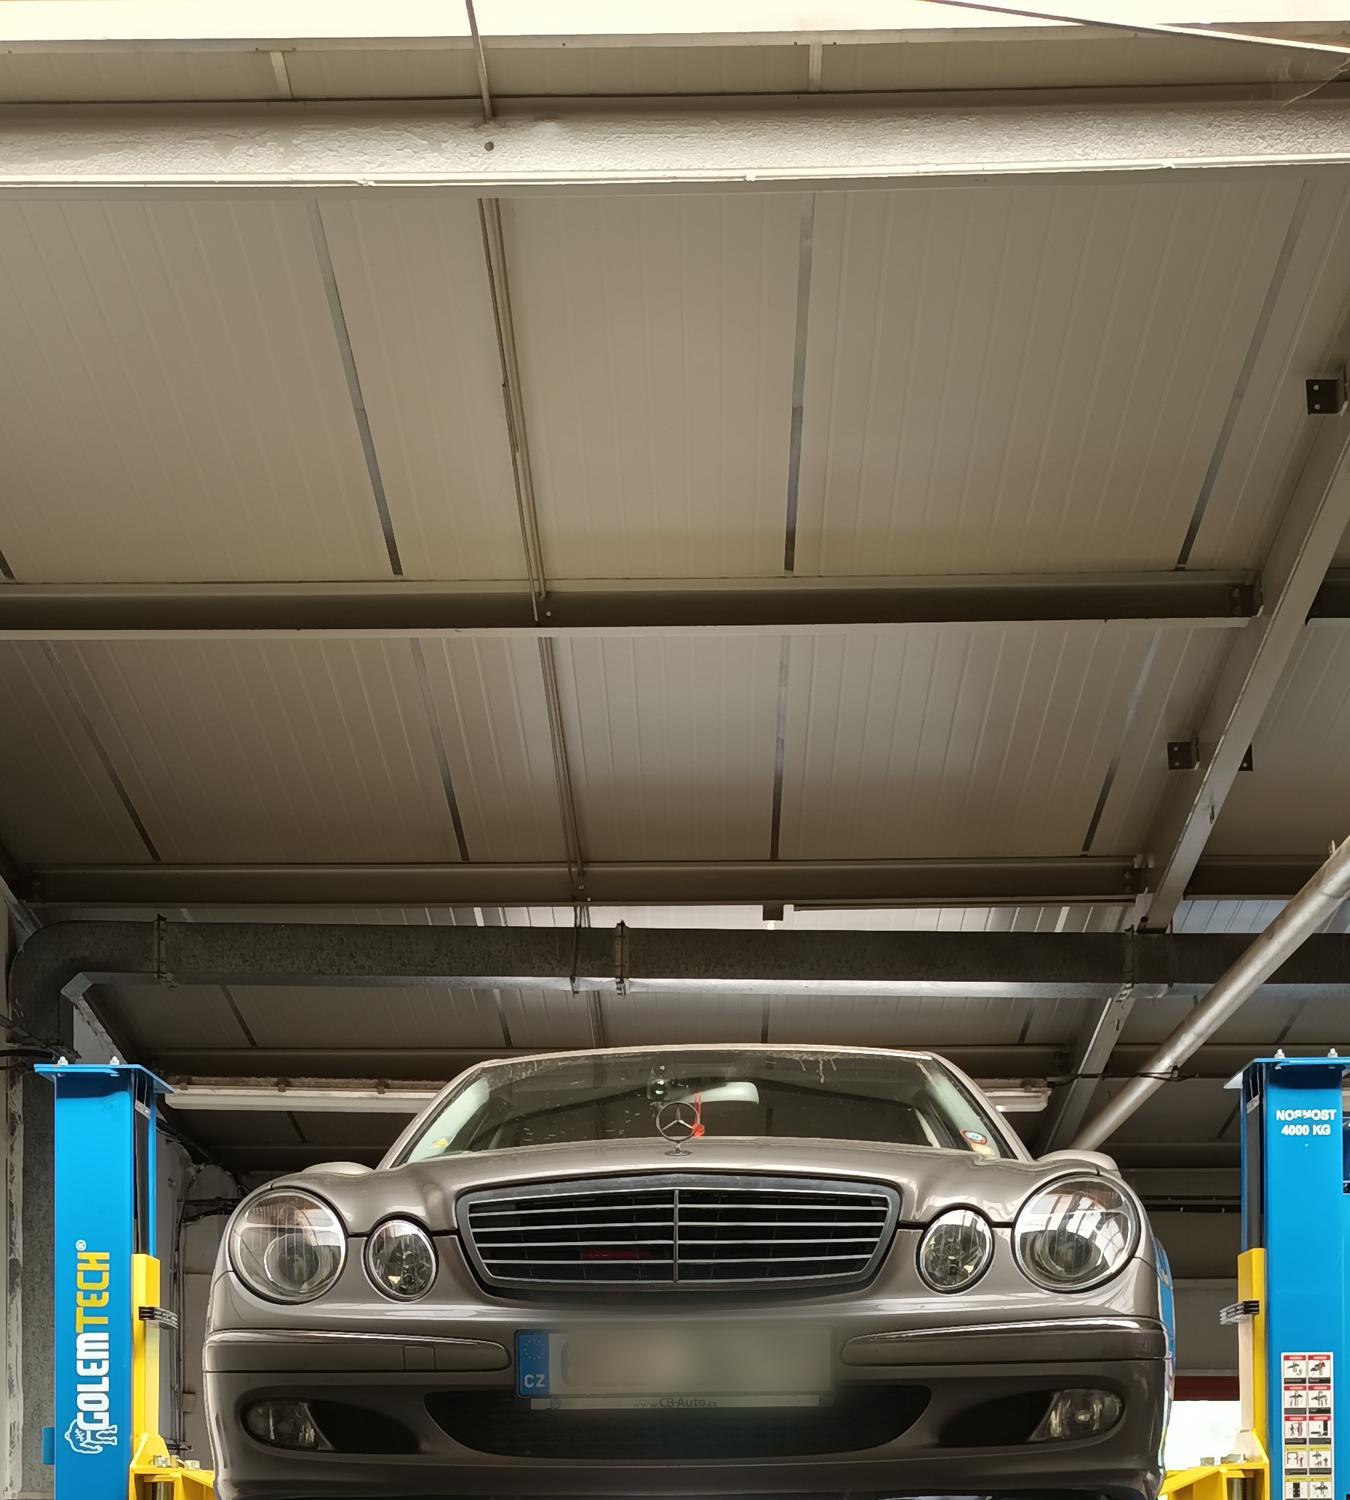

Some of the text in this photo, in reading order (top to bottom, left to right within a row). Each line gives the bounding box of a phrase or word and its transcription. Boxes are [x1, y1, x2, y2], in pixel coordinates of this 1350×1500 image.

[1281, 1124, 1331, 1136] 4000 KG
[524, 1374, 545, 1388] CZ
